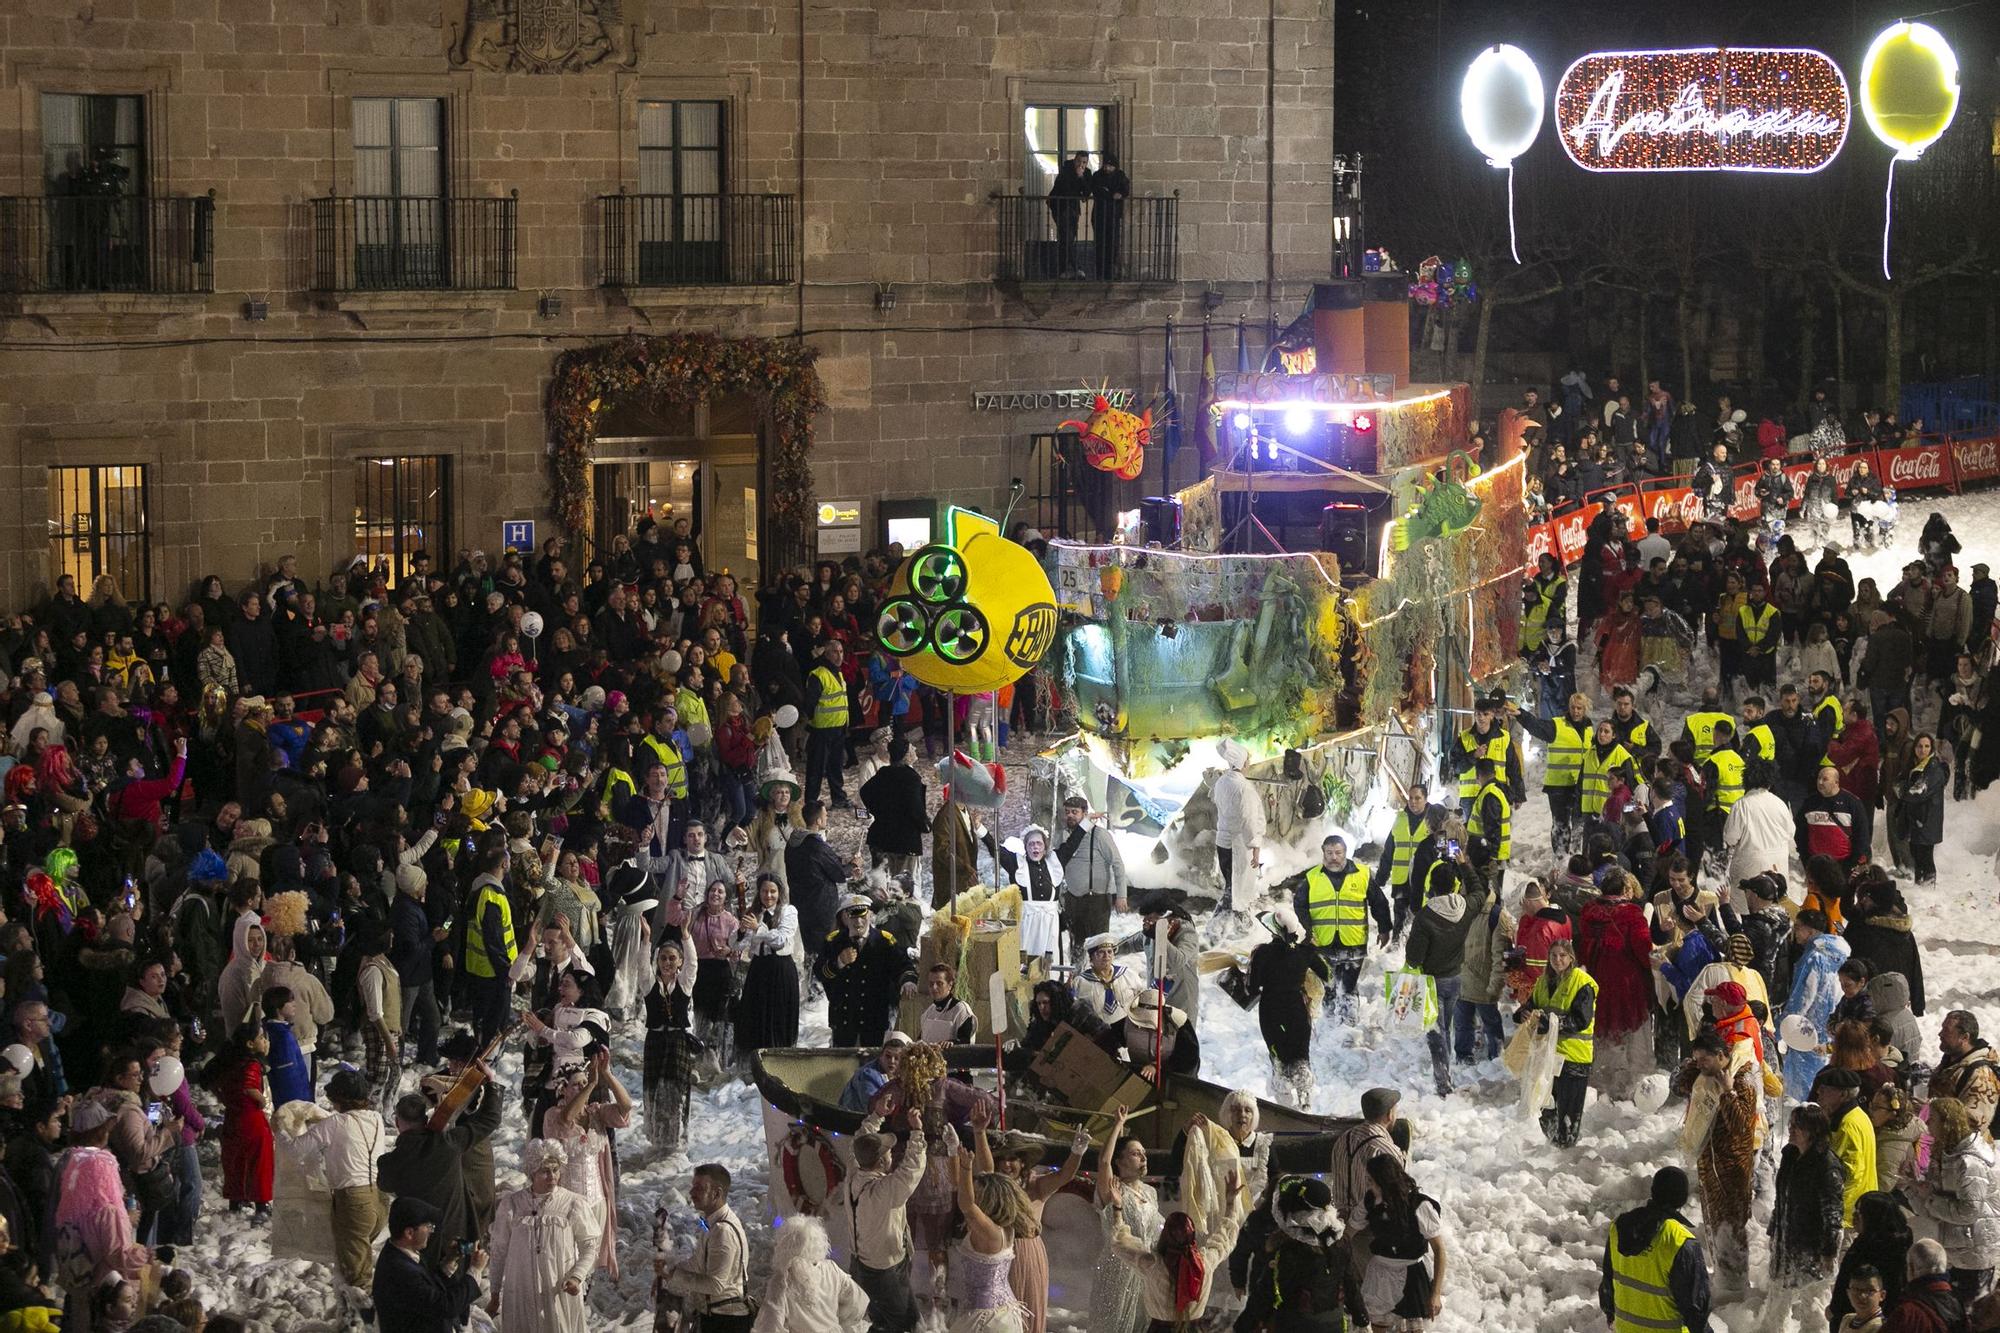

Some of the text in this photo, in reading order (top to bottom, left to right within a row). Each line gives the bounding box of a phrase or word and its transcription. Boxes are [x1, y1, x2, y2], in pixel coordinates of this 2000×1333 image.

[976, 393, 1051, 410] PALACIO
[1057, 392, 1080, 409] DE
[1890, 451, 1941, 482] Coca-Cola
[511, 525, 527, 542] H
[1062, 569, 1077, 588] 25
